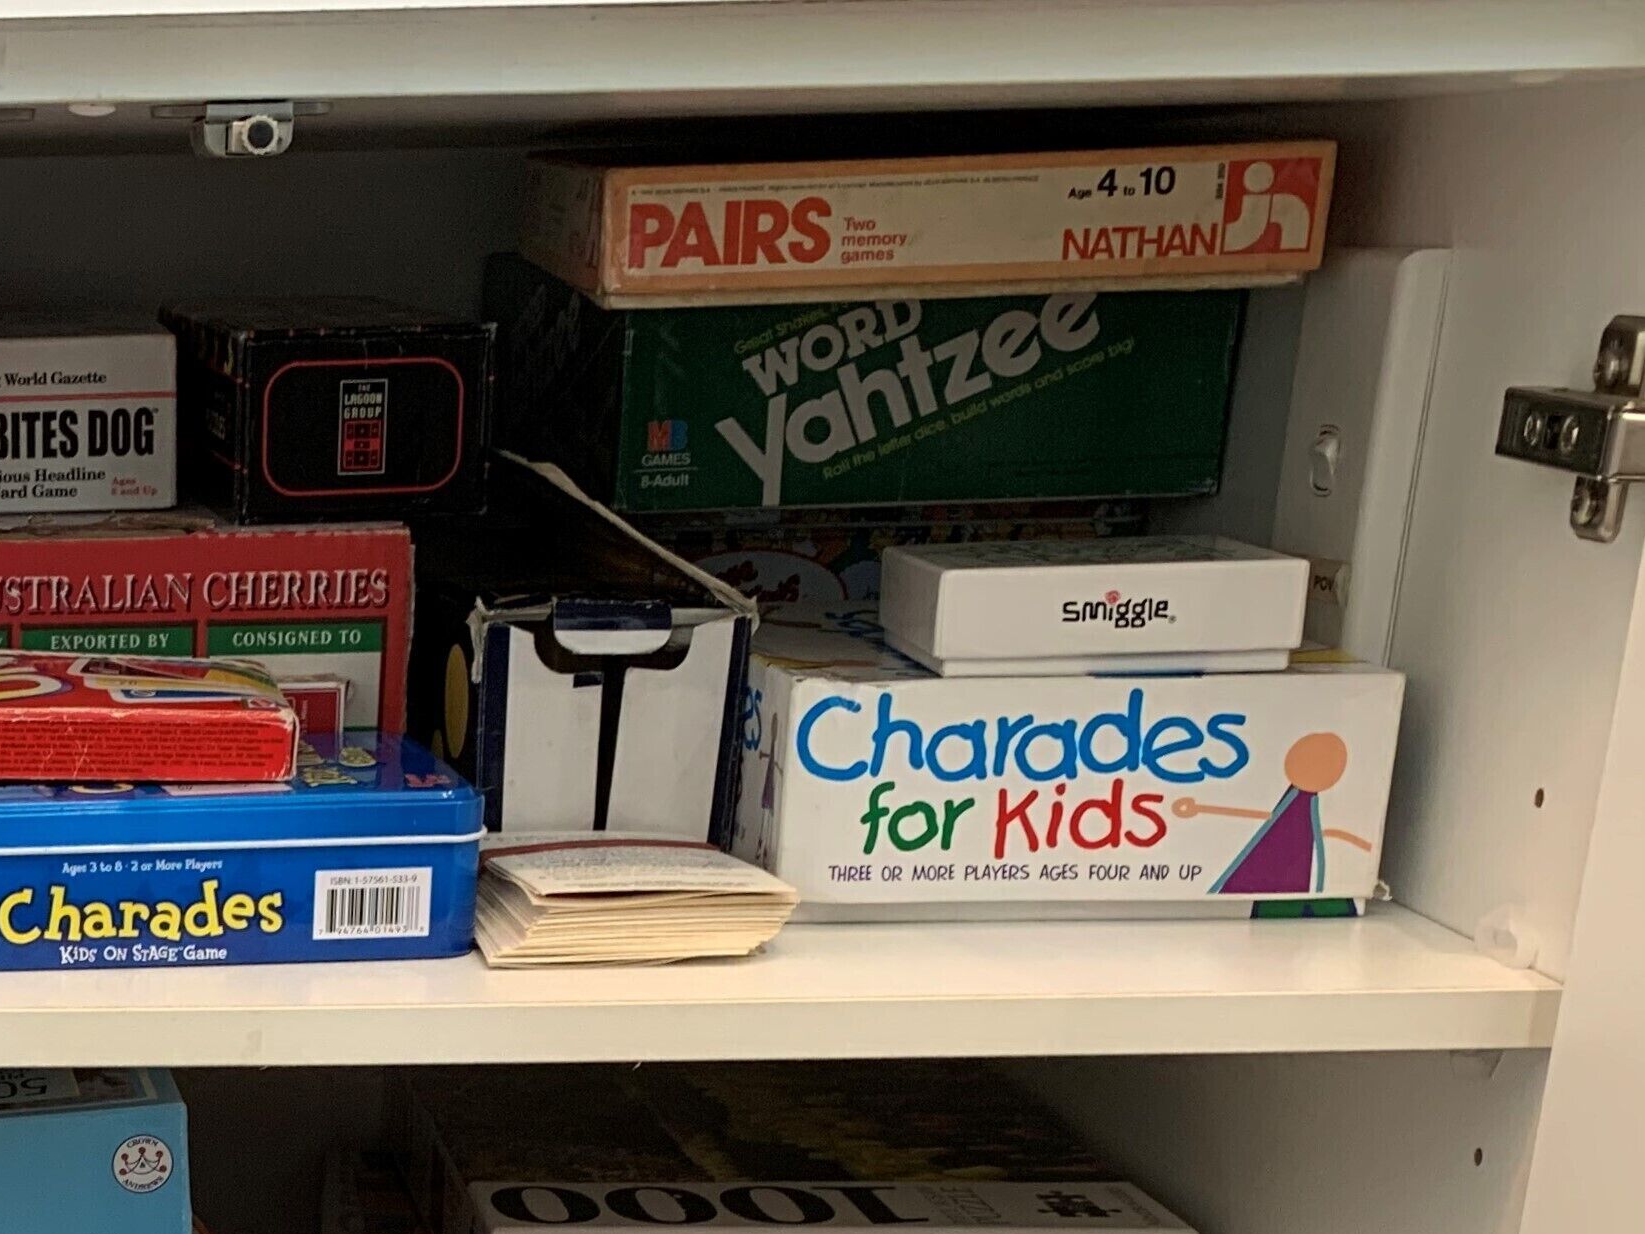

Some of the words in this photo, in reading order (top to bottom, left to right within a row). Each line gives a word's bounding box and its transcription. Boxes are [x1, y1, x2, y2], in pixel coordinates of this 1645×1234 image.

[1068, 187, 1092, 199] Age
[1097, 168, 1118, 197] 4
[1123, 184, 1135, 196] to
[1140, 165, 1176, 195] 10
[627, 196, 832, 269] PAIRS
[843, 216, 877, 232] Two
[841, 231, 907, 250] memory
[1062, 223, 1218, 260] NATHAN
[841, 247, 895, 264] games
[742, 300, 924, 396] WORD
[3, 371, 48, 386] World
[50, 370, 107, 385] Gazette
[715, 292, 1102, 506] Yahtzee
[87, 406, 155, 458] DOG
[647, 420, 688, 450] MB
[641, 452, 691, 467] GAMES
[33, 467, 106, 483] Headline
[32, 484, 78, 498] Game
[203, 567, 391, 611] CHERRIES
[1062, 591, 1169, 629] smiggle
[50, 631, 143, 652] EXPORTED
[148, 630, 171, 649] BY
[232, 629, 332, 648] CONSIGNED
[337, 627, 363, 645] TO
[795, 687, 1251, 785] Charades
[860, 779, 976, 857] for
[994, 778, 1169, 860] Kids
[62, 862, 87, 877] Ages
[89, 861, 98, 873] 3
[99, 861, 112, 872] to
[130, 861, 139, 872] 2
[140, 862, 152, 871] or
[155, 859, 182, 871] More
[184, 858, 223, 873] Players
[827, 864, 873, 883] THREE
[880, 864, 904, 883] OR
[911, 863, 956, 883] MORE
[964, 863, 1031, 882] PLAYERS
[1038, 863, 1080, 881] AGES
[1087, 863, 1131, 881] FOUR
[1138, 863, 1171, 881] AND
[1179, 863, 1203, 881] UP
[103, 946, 128, 962] ON
[182, 944, 228, 961] Game
[492, 1185, 930, 1226] 1000
